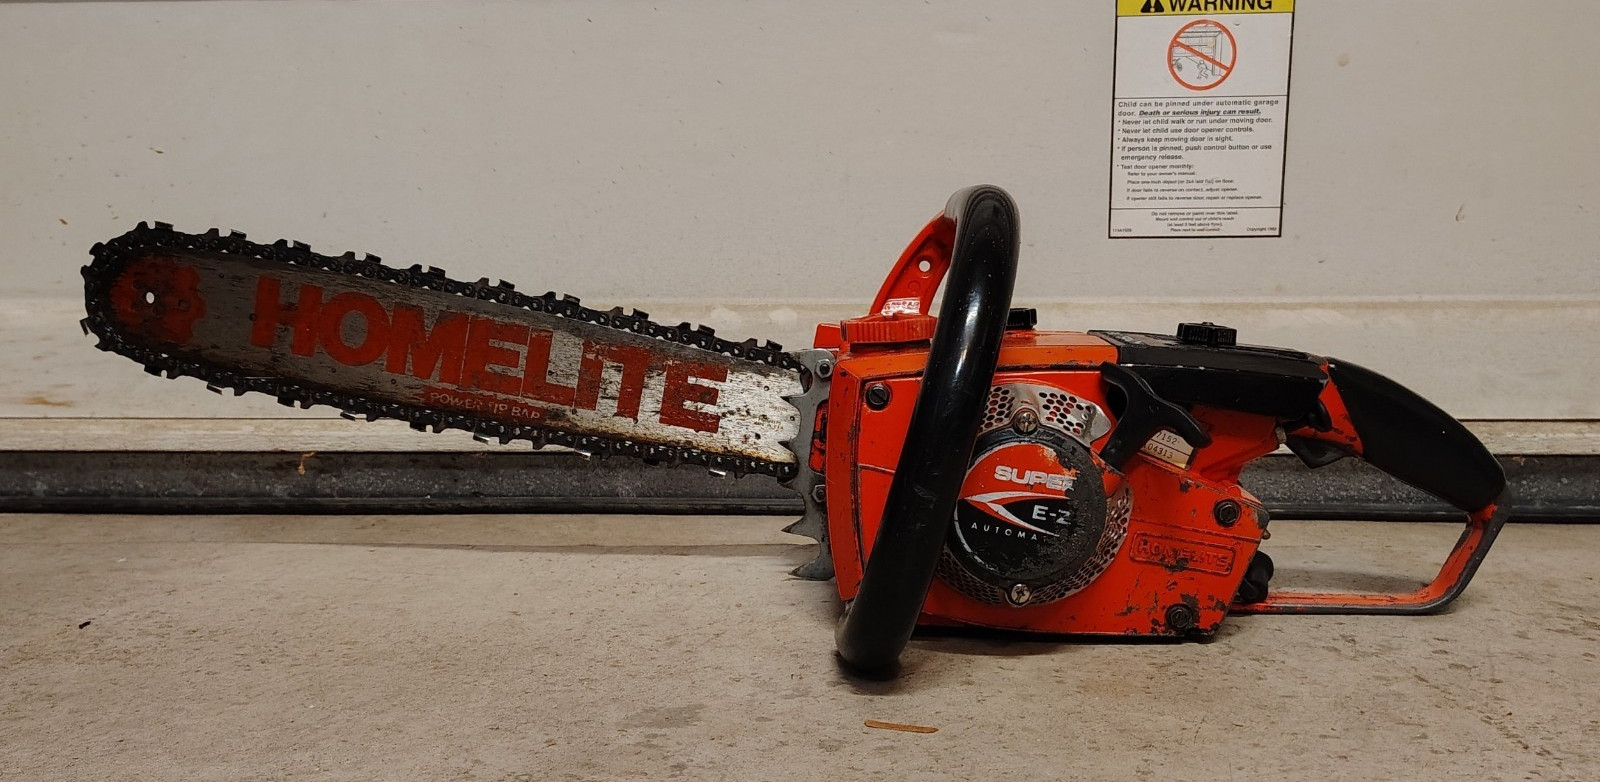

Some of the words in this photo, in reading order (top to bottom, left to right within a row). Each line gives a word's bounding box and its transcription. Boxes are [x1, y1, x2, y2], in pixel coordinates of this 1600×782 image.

[1169, 0, 1272, 12] WARNING
[251, 274, 728, 434] HOMELITE
[1143, 443, 1174, 459] 04313
[971, 522, 1046, 542] AUTOMA
[1137, 537, 1229, 570] HOMELITE
